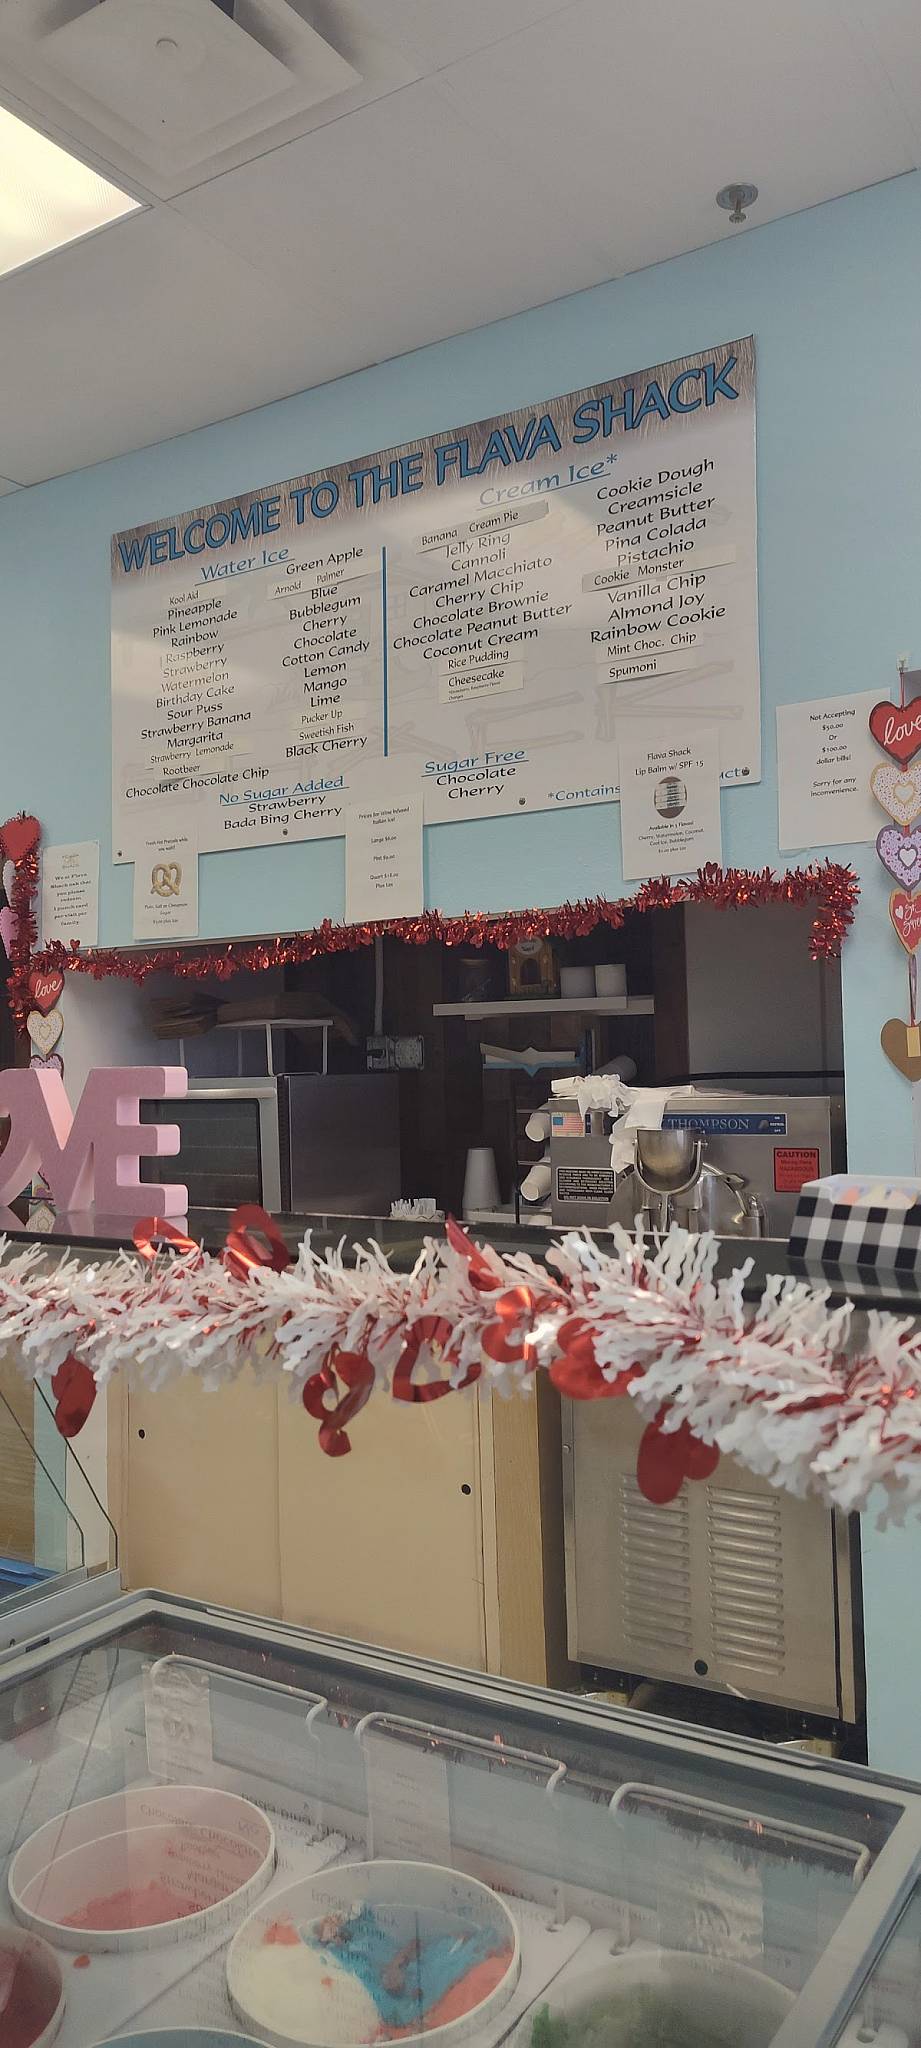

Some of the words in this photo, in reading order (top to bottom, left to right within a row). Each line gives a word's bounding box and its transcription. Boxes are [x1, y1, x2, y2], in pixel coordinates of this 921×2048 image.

[118, 495, 280, 573] WELCOME
[290, 480, 339, 525] TO
[348, 451, 423, 508] THE
[434, 413, 562, 486] FLAVA
[572, 355, 739, 444] SHACK
[479, 474, 559, 505] Cream
[596, 477, 652, 500] Cookie
[657, 459, 714, 485] Dough
[608, 481, 703, 515] Creamsicle
[421, 529, 458, 546] Banana
[469, 517, 501, 533] Cream
[503, 510, 519, 523] Pie
[596, 512, 654, 536] Peanut
[659, 497, 716, 520] Butter
[446, 541, 473, 558] Jelly
[478, 533, 511, 549] Ring
[604, 535, 641, 552] Pina
[646, 518, 707, 541] Colada
[200, 557, 256, 580] Water
[262, 548, 289, 564] Ice
[286, 559, 323, 575] Green
[326, 547, 363, 566] Apple
[451, 548, 506, 571] Cannoli
[617, 539, 694, 567] Pistachio
[274, 580, 302, 596] Arnold
[316, 568, 345, 585] Palmer
[409, 574, 470, 598] Caramel
[474, 557, 552, 583] Macchiato
[594, 570, 630, 586] Cookie
[637, 558, 685, 577] Monster
[169, 593, 186, 605] Kool
[187, 590, 199, 601] Aid
[311, 586, 338, 600] Blue
[435, 589, 486, 608] Cherry
[490, 580, 524, 596] Chip
[608, 584, 661, 604] Vanilla
[667, 573, 706, 591] Chip
[168, 599, 222, 620] Pineapple
[289, 596, 361, 620] Bubblegum
[413, 606, 484, 629] Chocolate
[488, 591, 549, 613] Brownie
[608, 597, 673, 623] Almond
[679, 593, 705, 609] Joy
[153, 624, 176, 638] Pink
[179, 610, 238, 632] Lemonade
[303, 615, 347, 632] Cherry
[393, 627, 463, 650] Chocolate
[467, 614, 518, 635] Peanut
[522, 604, 572, 622] Butter
[590, 620, 662, 643] Rainbow
[667, 605, 726, 627] Cookie
[171, 630, 219, 648] Rainbow
[293, 628, 357, 649] Chocolate
[423, 638, 482, 660] Coconut
[487, 628, 538, 647] Cream
[607, 644, 631, 657] Mint
[634, 639, 665, 652] Choc.
[670, 631, 697, 646] Chip
[166, 643, 225, 664] Raspberry
[282, 652, 324, 667] Cotton
[328, 640, 370, 658] Candy
[448, 659, 466, 669] Rice
[469, 649, 509, 665] Pudding
[163, 657, 228, 679] Strawberry
[304, 662, 347, 678] Lemon
[448, 669, 505, 687] Cheesecake
[609, 659, 657, 679] Spumoni
[161, 672, 229, 693] Watermelon
[303, 677, 348, 694] Mango
[156, 691, 203, 709] Birthday
[206, 685, 235, 699] Cake
[310, 695, 341, 708] Lime
[167, 708, 193, 721] Sour
[196, 702, 223, 715] Puss
[301, 712, 328, 724] Pucker
[331, 709, 343, 720] Up
[822, 709, 856, 719] Accepting
[140, 721, 204, 740] Strawberry
[207, 712, 251, 727] Banana
[336, 723, 355, 733] Fish
[167, 731, 223, 749] Margarita
[286, 742, 318, 758] Black
[322, 736, 367, 752] Cherry
[150, 750, 191, 764] Strawberry
[195, 741, 234, 756] Lemonade
[425, 756, 479, 774] Sugar
[485, 750, 525, 765] Free
[647, 751, 666, 761] Flava
[668, 747, 691, 758] Shack
[816, 757, 835, 765] dollar
[163, 764, 200, 776] Rootbeer
[436, 766, 516, 786] Chocolate
[635, 768, 646, 776] Lip
[648, 765, 667, 774] Balm
[679, 760, 693, 768] SPF
[125, 782, 179, 799] Chocolate
[182, 773, 239, 790] Chocolate
[242, 767, 269, 780] Chip
[219, 793, 239, 805] No
[243, 786, 288, 801] Sugar
[292, 776, 344, 794] Added
[448, 784, 504, 799] Cherry
[812, 780, 831, 788] Sorry
[832, 778, 842, 786] for
[843, 777, 857, 785] any
[248, 795, 326, 813] Strawberry
[224, 817, 256, 830] Bada
[260, 813, 289, 826] Bing
[294, 806, 342, 820] Cherry
[35, 979, 62, 999] love
[668, 1118, 750, 1130] THOMPSON
